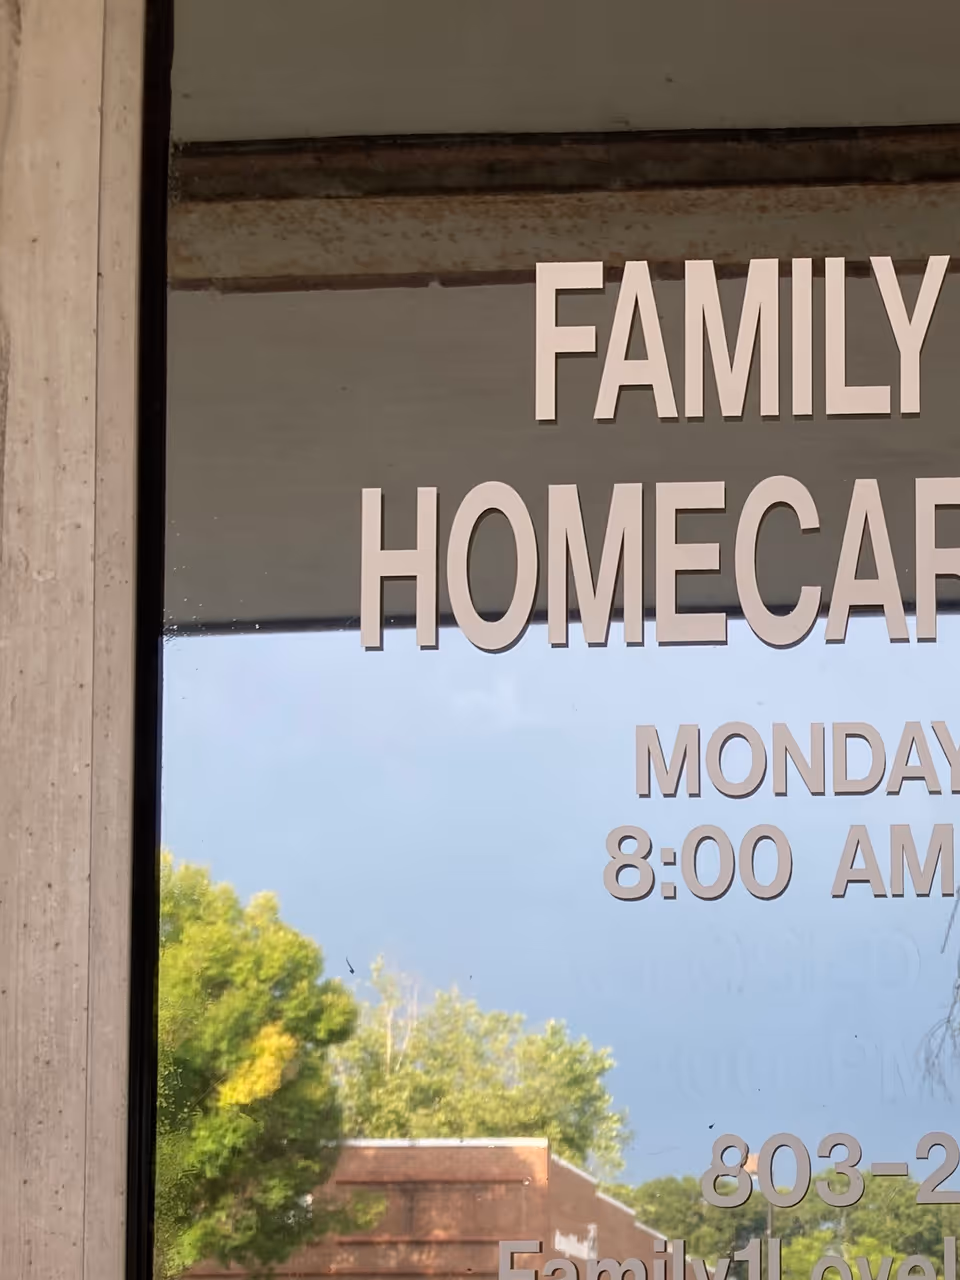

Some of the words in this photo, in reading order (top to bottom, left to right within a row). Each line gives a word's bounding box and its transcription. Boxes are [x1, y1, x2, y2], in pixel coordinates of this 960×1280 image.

[535, 255, 950, 420] FAMILY
[603, 824, 793, 901] 8:00
[831, 823, 954, 898] AM
